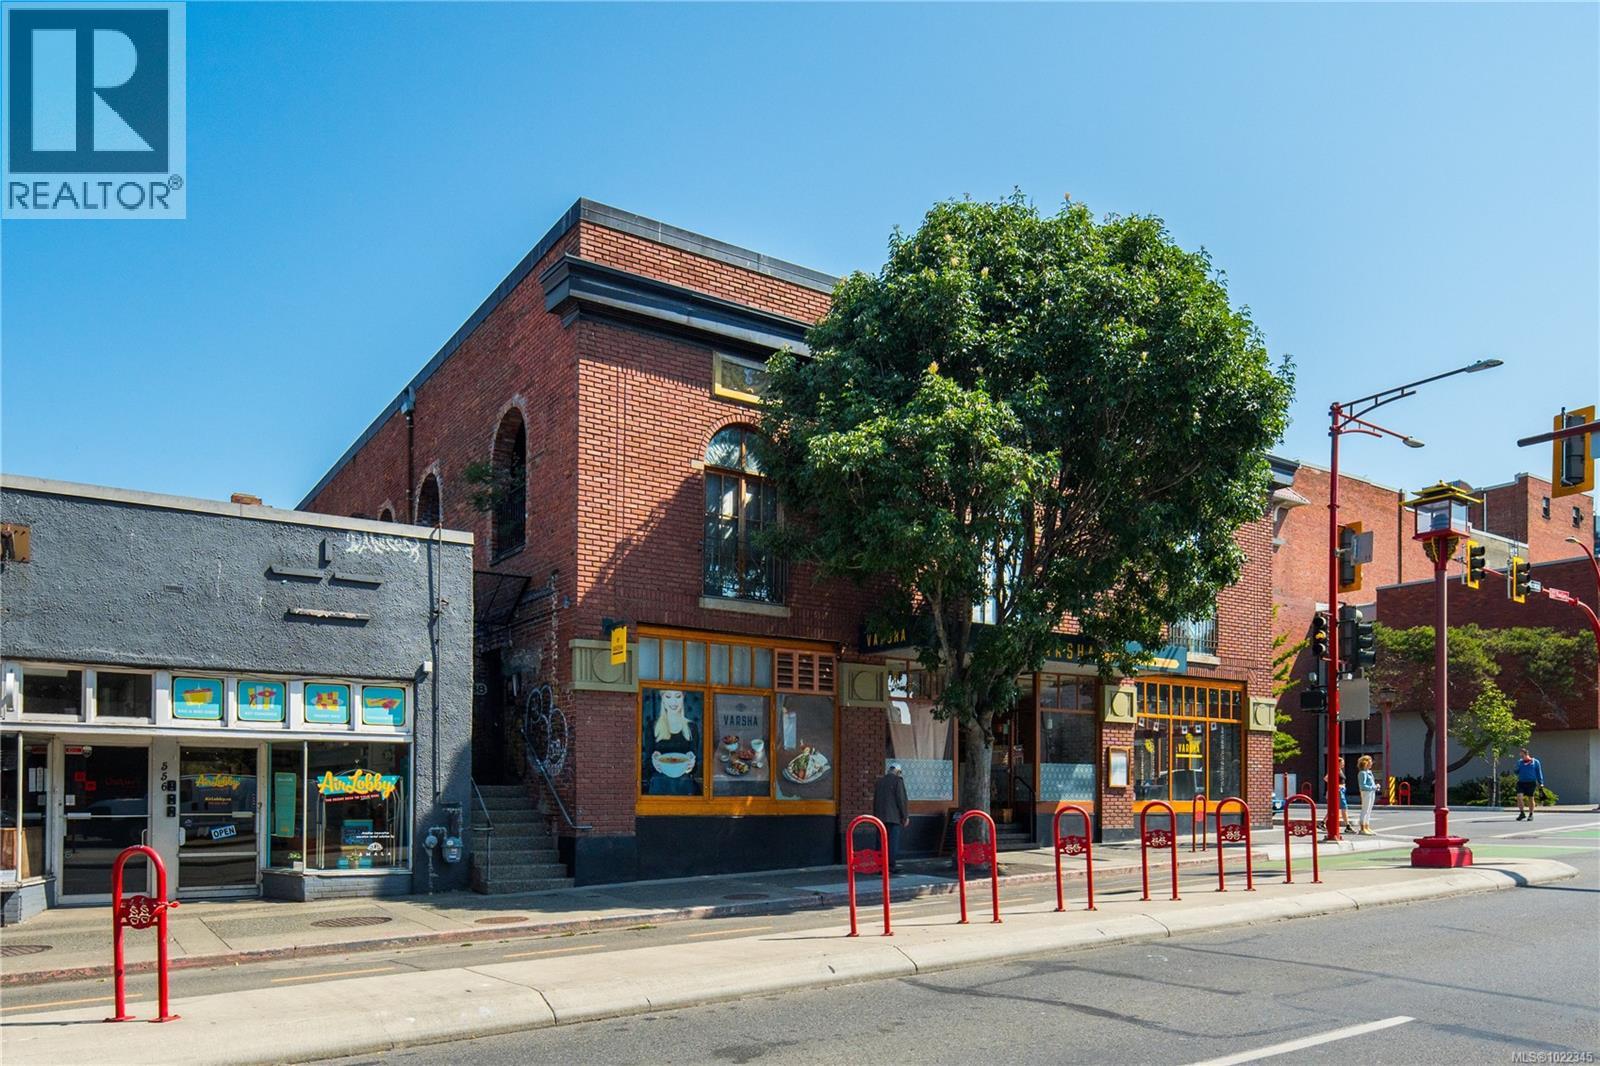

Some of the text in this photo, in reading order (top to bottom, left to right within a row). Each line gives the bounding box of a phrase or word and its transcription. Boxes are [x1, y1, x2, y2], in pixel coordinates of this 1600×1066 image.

[723, 715, 758, 727] VARSHA
[195, 773, 240, 792] AirLobby
[317, 769, 396, 798] AirLobby
[213, 825, 236, 838] OPEN
